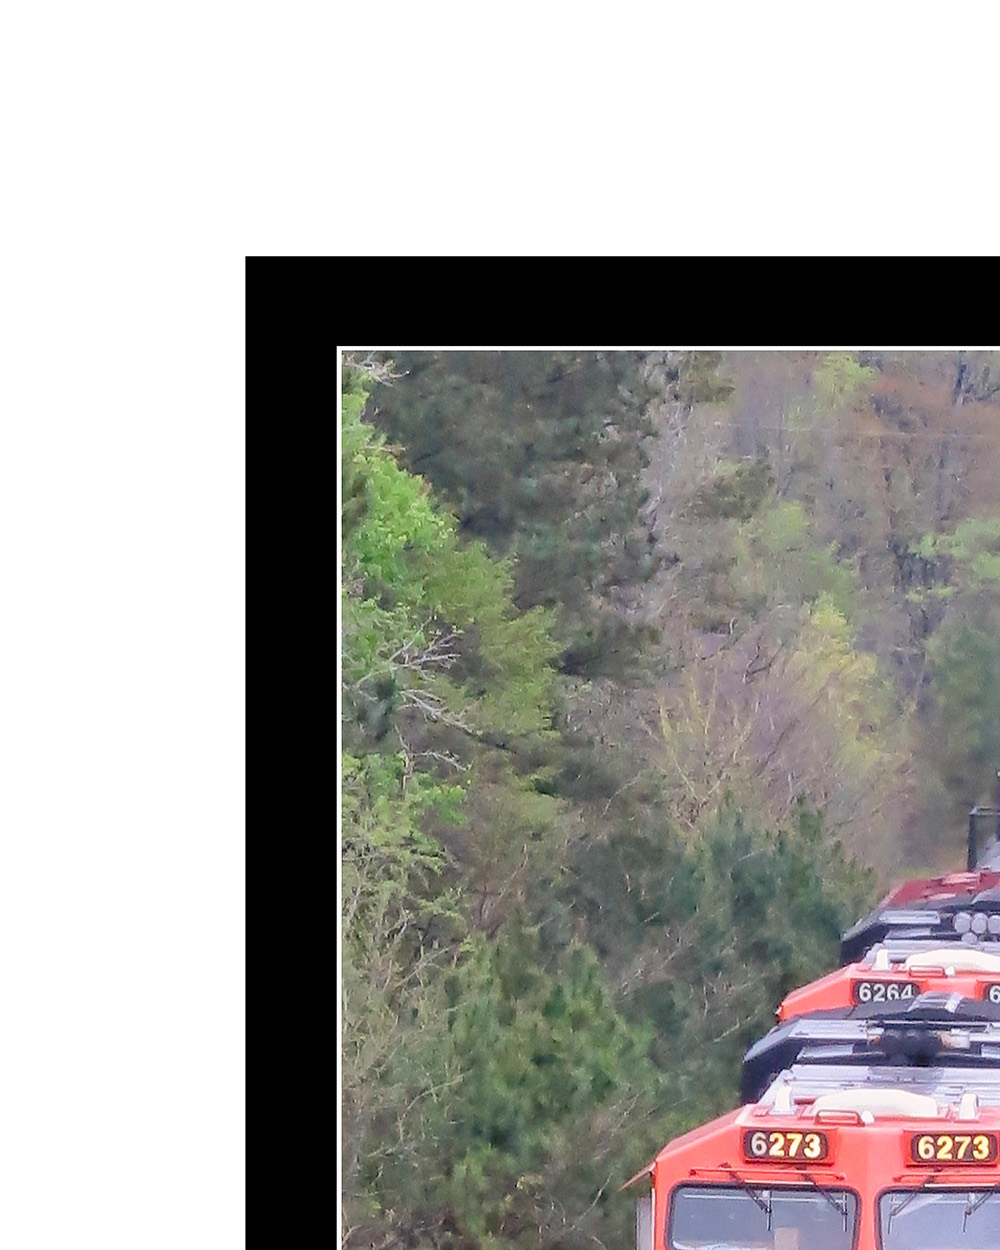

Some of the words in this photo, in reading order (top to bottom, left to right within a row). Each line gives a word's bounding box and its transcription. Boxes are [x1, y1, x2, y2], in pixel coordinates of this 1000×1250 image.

[858, 982, 915, 1002] 6264
[750, 1131, 822, 1159] 6273
[917, 1134, 990, 1161] 6273
